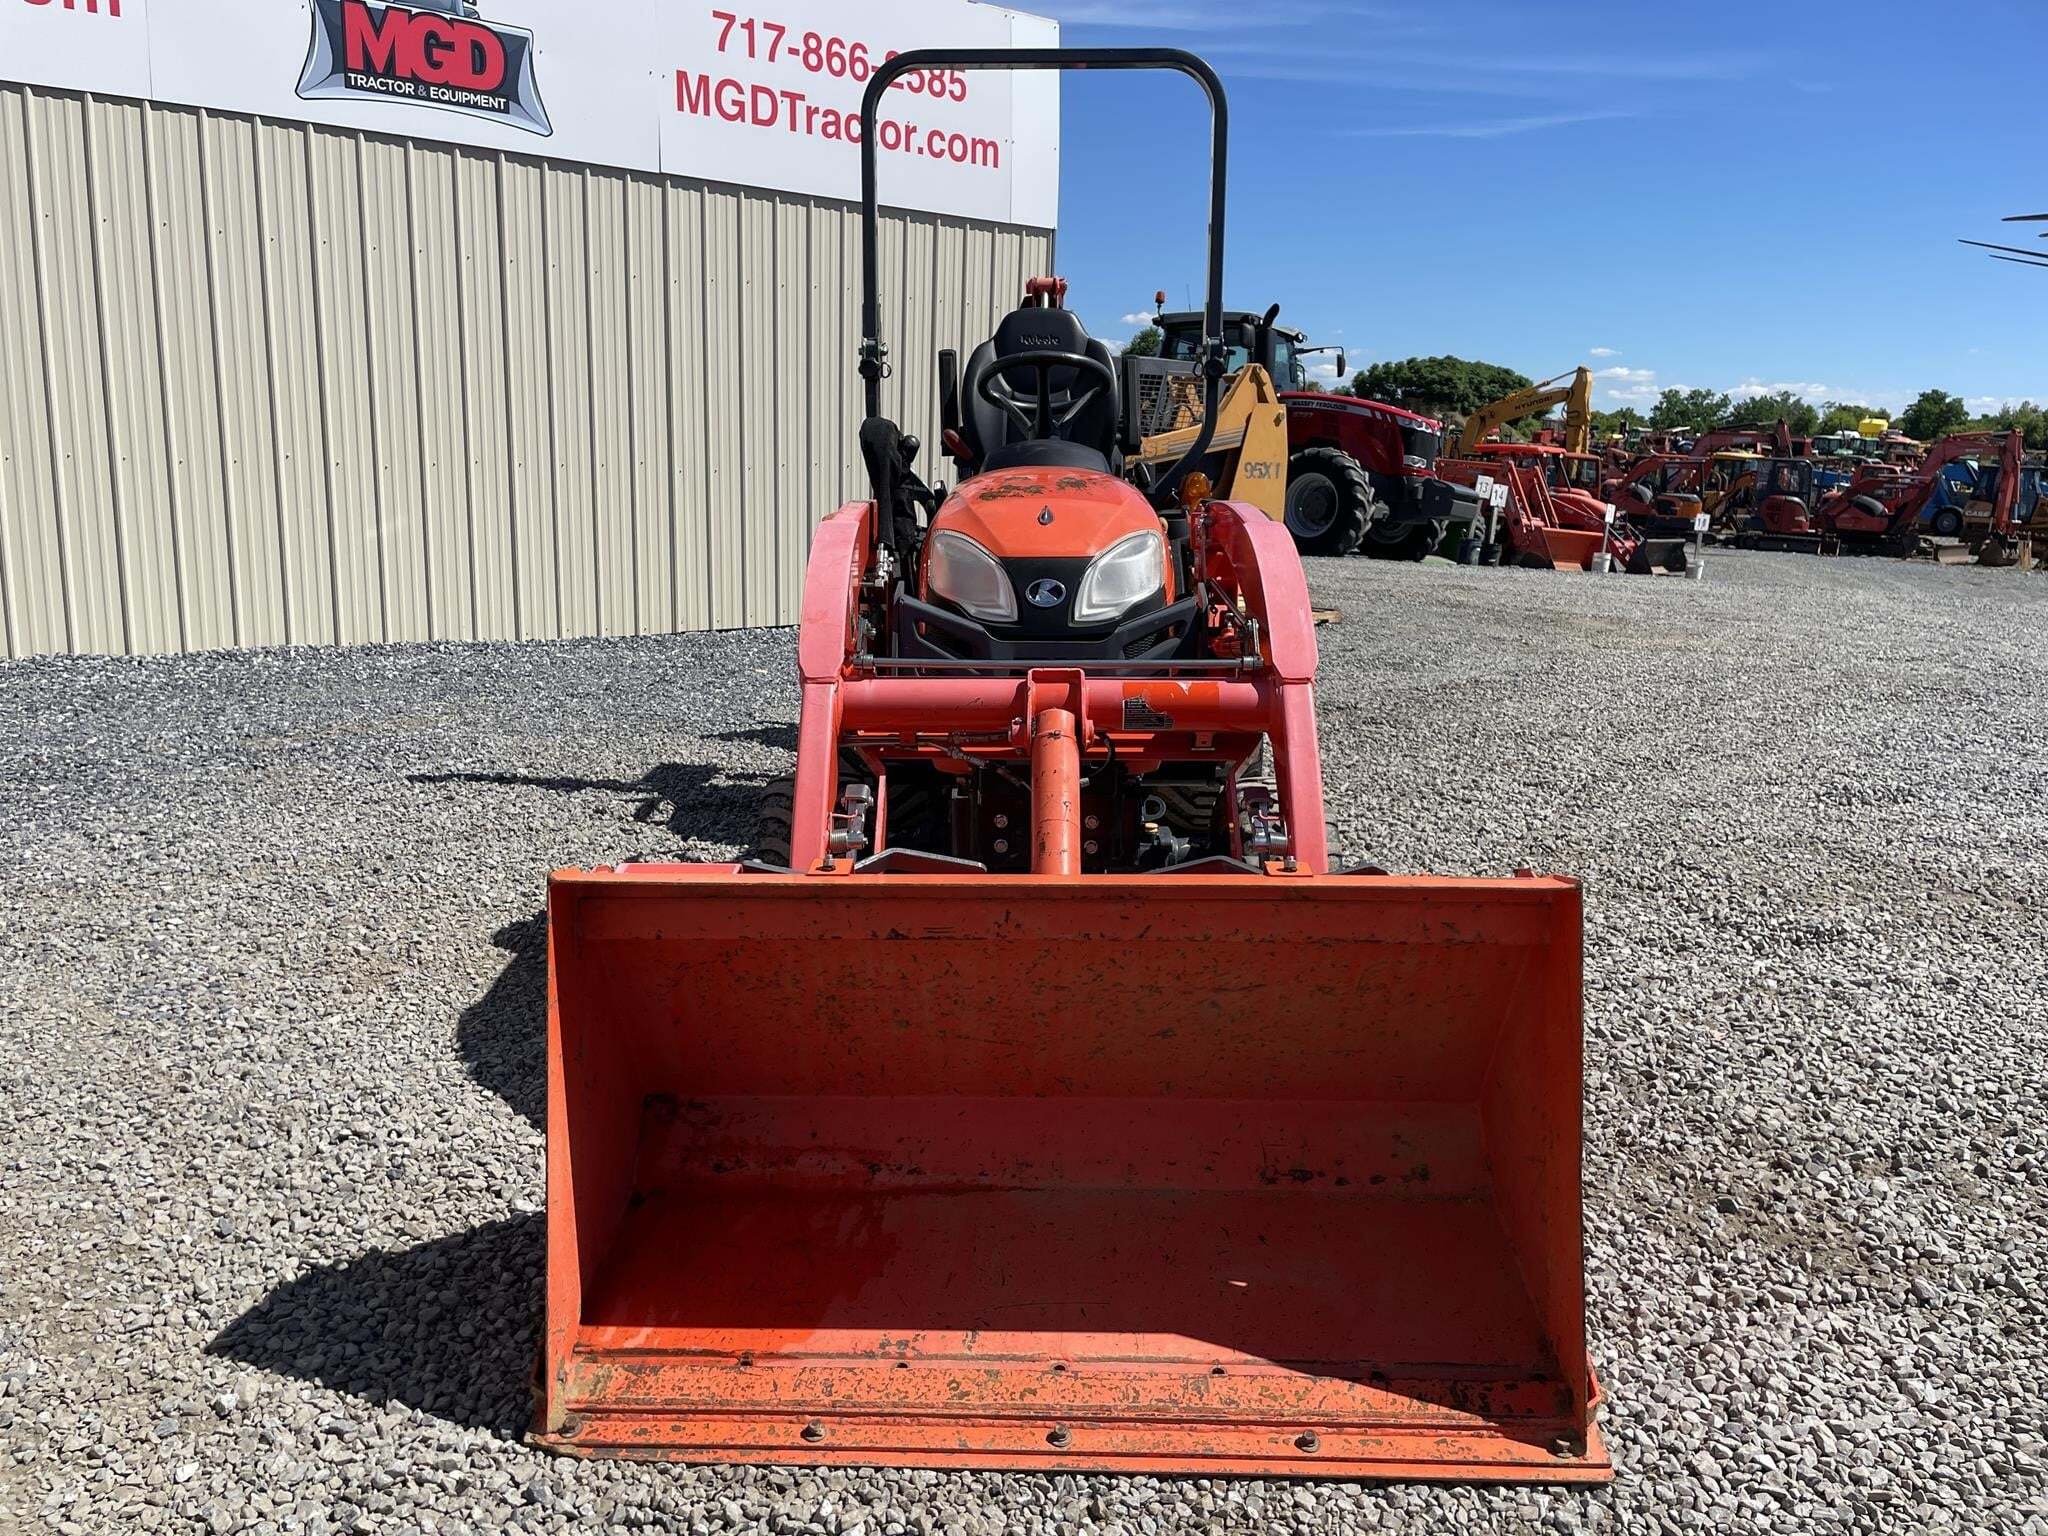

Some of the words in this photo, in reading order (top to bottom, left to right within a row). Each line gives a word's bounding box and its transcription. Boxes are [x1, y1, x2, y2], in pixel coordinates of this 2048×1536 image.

[342, 1, 506, 92] MGD
[348, 73, 416, 96] TRACTOR
[417, 84, 427, 97] &
[429, 86, 508, 110] EQUIPMENT
[675, 69, 999, 168] MGDTracor.com
